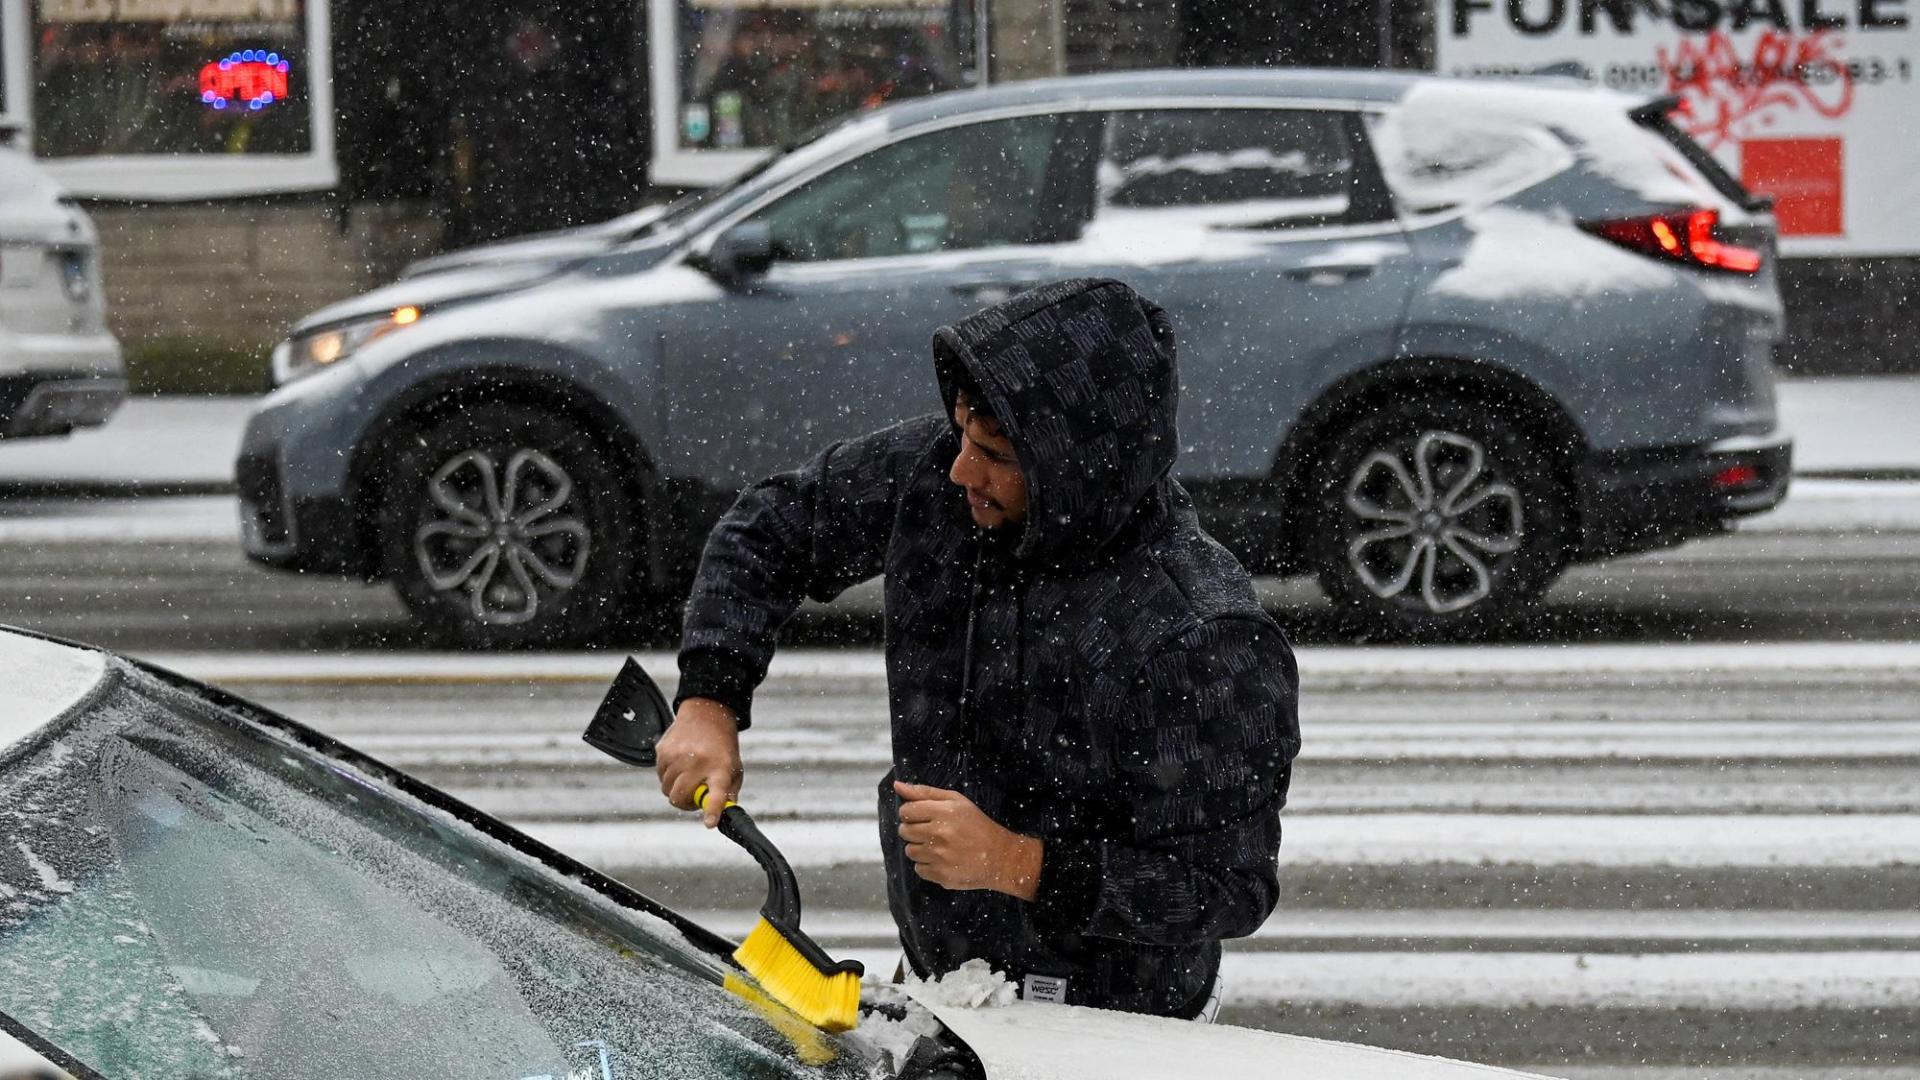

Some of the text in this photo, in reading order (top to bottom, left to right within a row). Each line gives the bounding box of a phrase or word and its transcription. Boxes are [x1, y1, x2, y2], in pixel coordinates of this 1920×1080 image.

[1452, 0, 1910, 36] FOR SALE
[199, 62, 288, 100] OPEN
